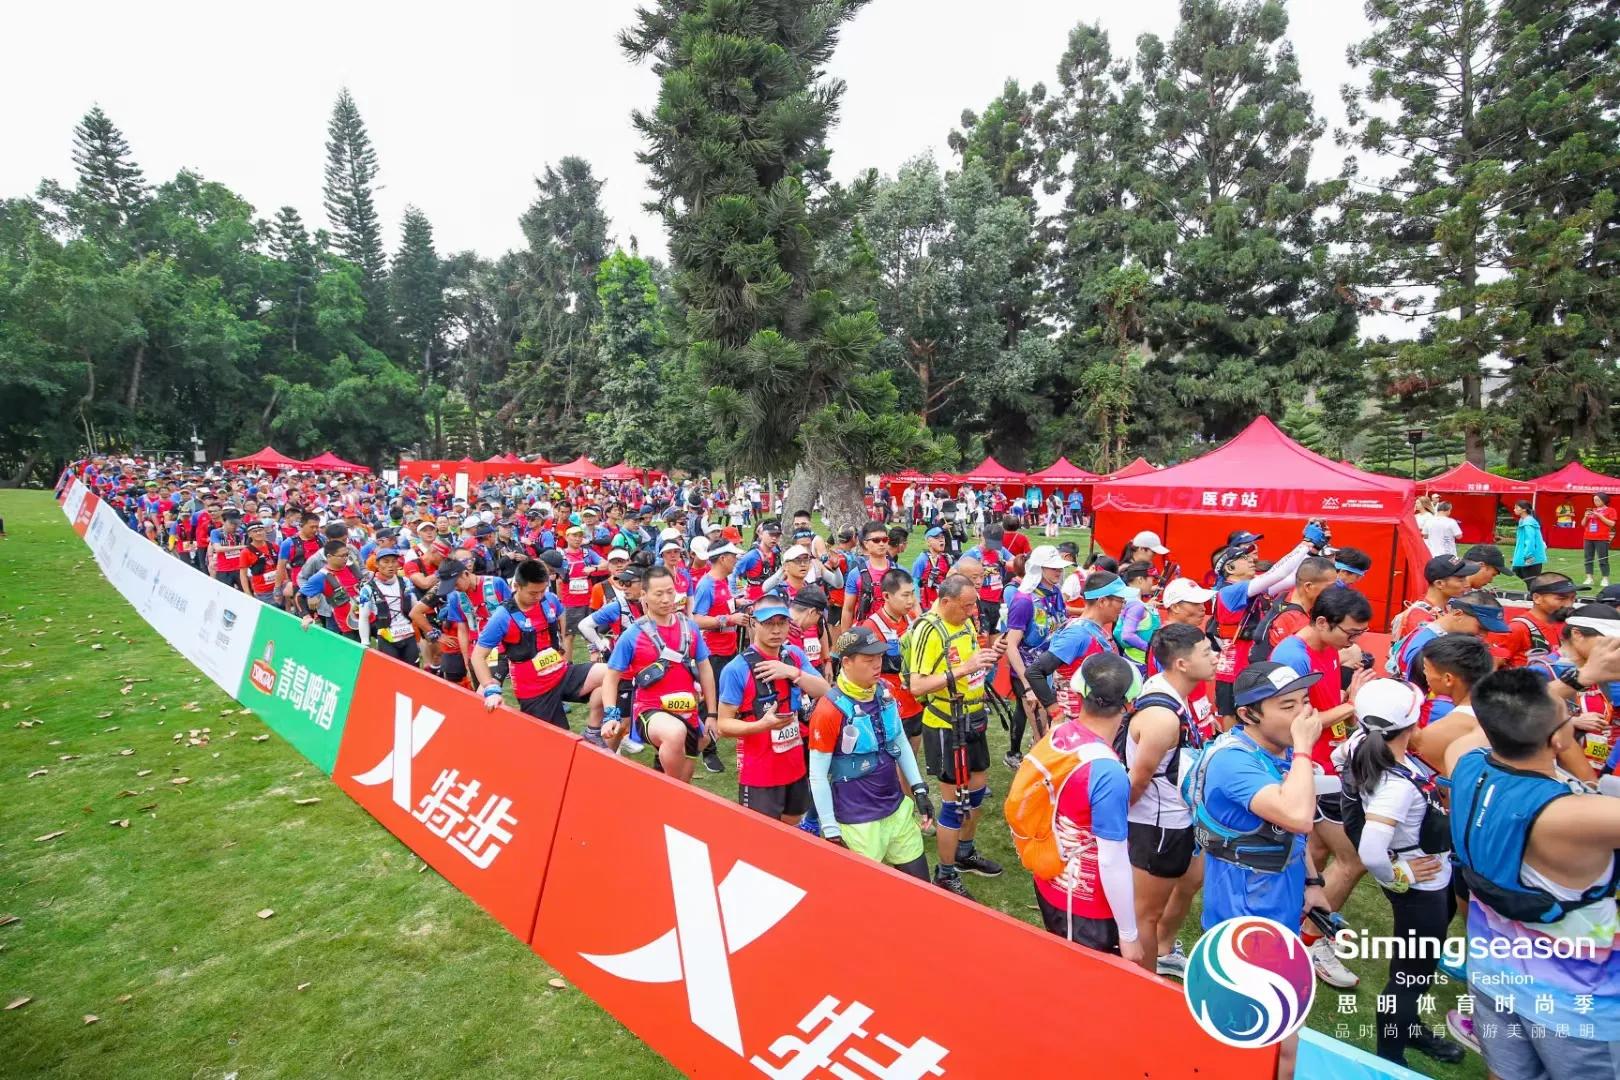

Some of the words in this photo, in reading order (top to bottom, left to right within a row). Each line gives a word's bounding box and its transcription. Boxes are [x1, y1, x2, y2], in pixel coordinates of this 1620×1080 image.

[1202, 491, 1258, 508] 医疗站
[539, 653, 559, 667] B027
[276, 657, 341, 731] 青岛啤酒
[667, 700, 690, 710] B024
[778, 726, 799, 741] A039
[411, 768, 519, 869] 特步
